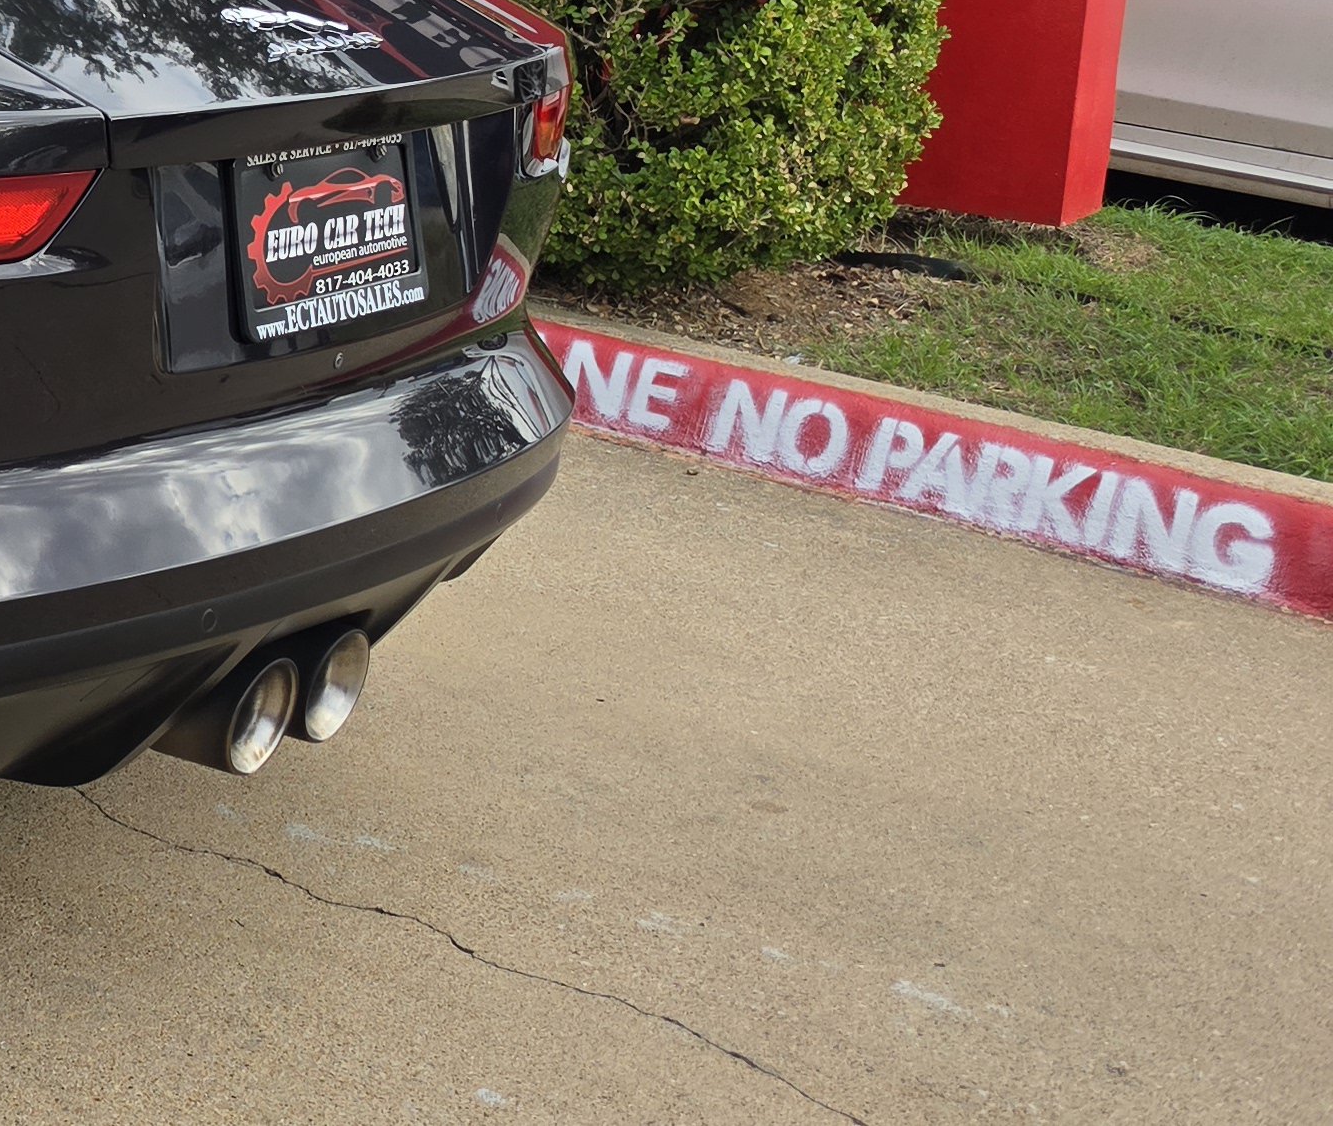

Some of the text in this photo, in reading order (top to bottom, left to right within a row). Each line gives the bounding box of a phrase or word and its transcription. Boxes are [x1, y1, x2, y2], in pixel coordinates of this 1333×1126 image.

[246, 152, 277, 167] SALES
[289, 144, 332, 160] SERVICE
[265, 203, 406, 263] EURO CAR TECH
[312, 234, 408, 267] european automotive
[315, 259, 410, 294] 817-404-4033
[256, 279, 425, 340] www.ECTAUTOSALES.com
[561, 336, 1275, 596] NE NO PARKING
